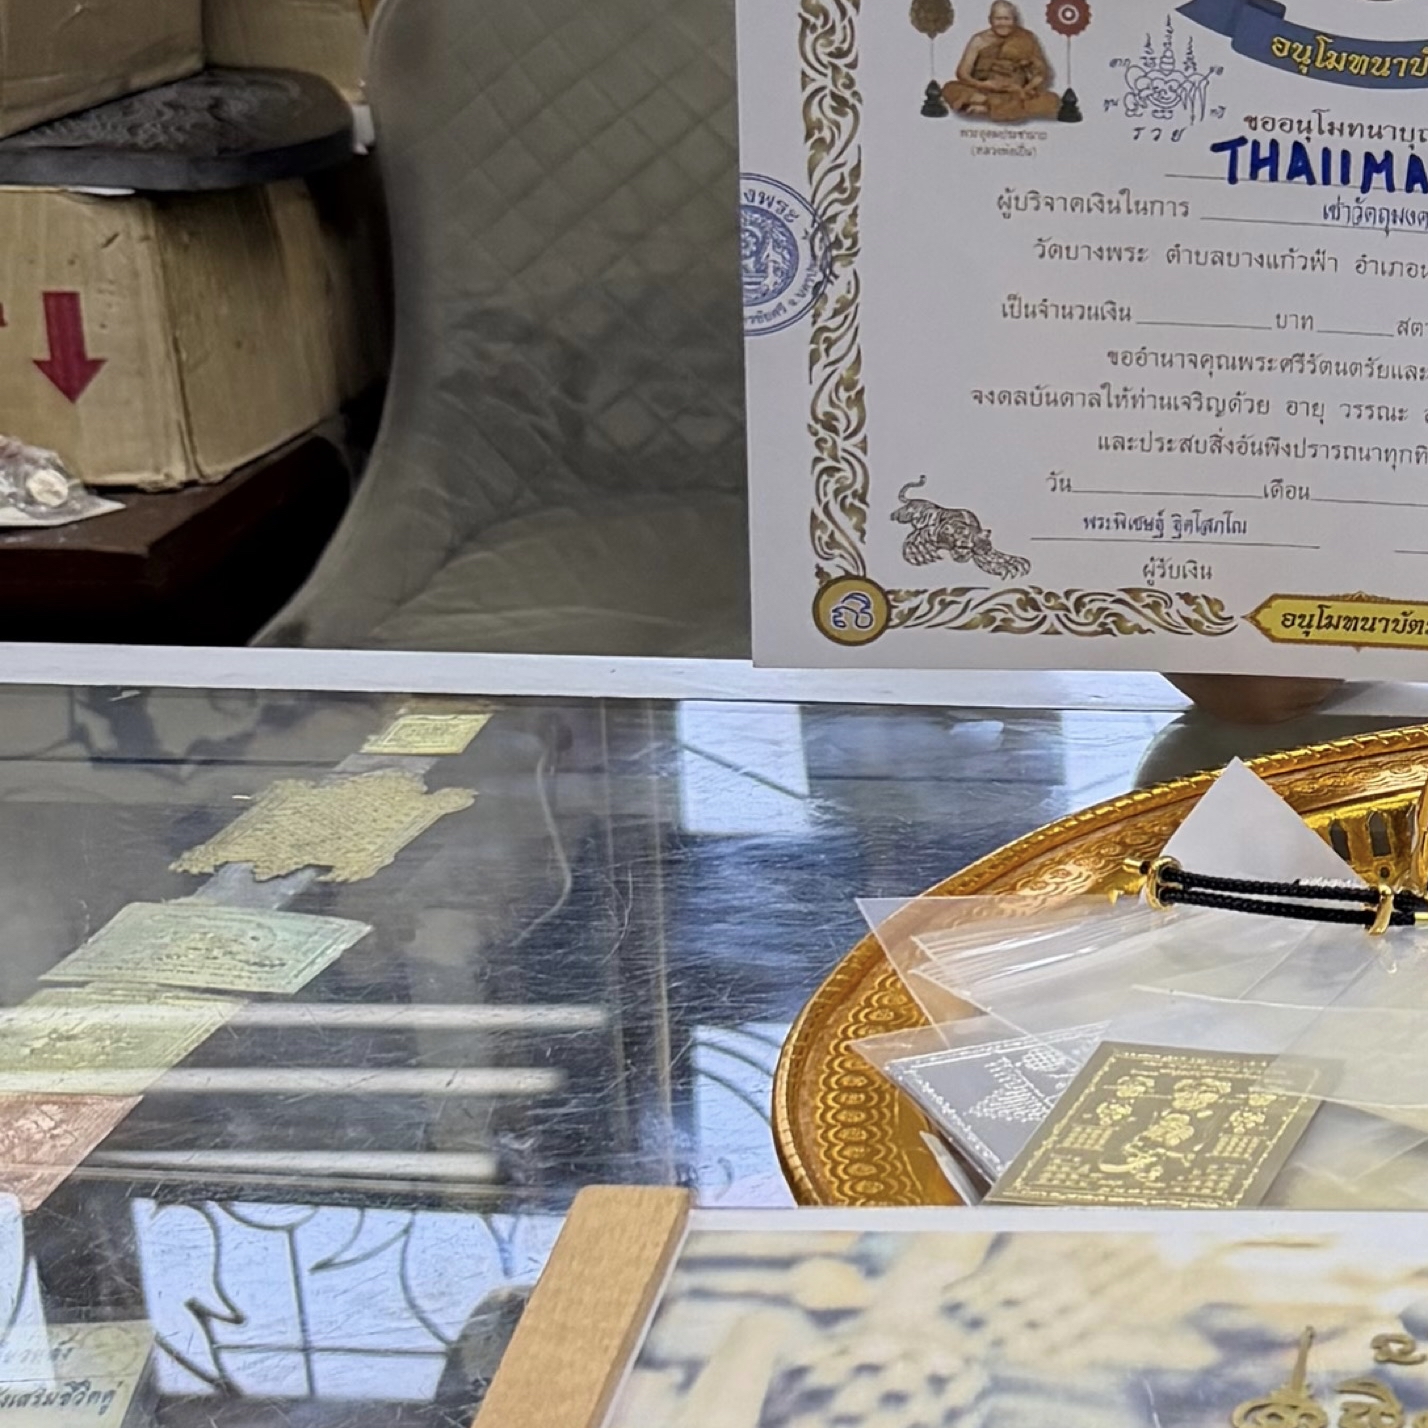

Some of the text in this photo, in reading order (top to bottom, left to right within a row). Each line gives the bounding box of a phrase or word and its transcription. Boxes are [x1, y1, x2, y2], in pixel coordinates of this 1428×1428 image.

[997, 188, 1190, 221] ผู้บริจาคเงินในการ
[1033, 237, 1150, 263] วัดบางพระ
[1166, 243, 1340, 274] ตำบลบางแก้วฟ้า
[1001, 292, 1132, 323] เป็นจำนวนเงิน
[1276, 313, 1315, 331] บาท
[1286, 398, 1326, 425] อายุ
[1339, 402, 1409, 423] วรรณะ
[1044, 471, 1073, 494] วัน
[1263, 477, 1311, 502] เดือน
[1142, 557, 1214, 586] ผู้รับเงิน
